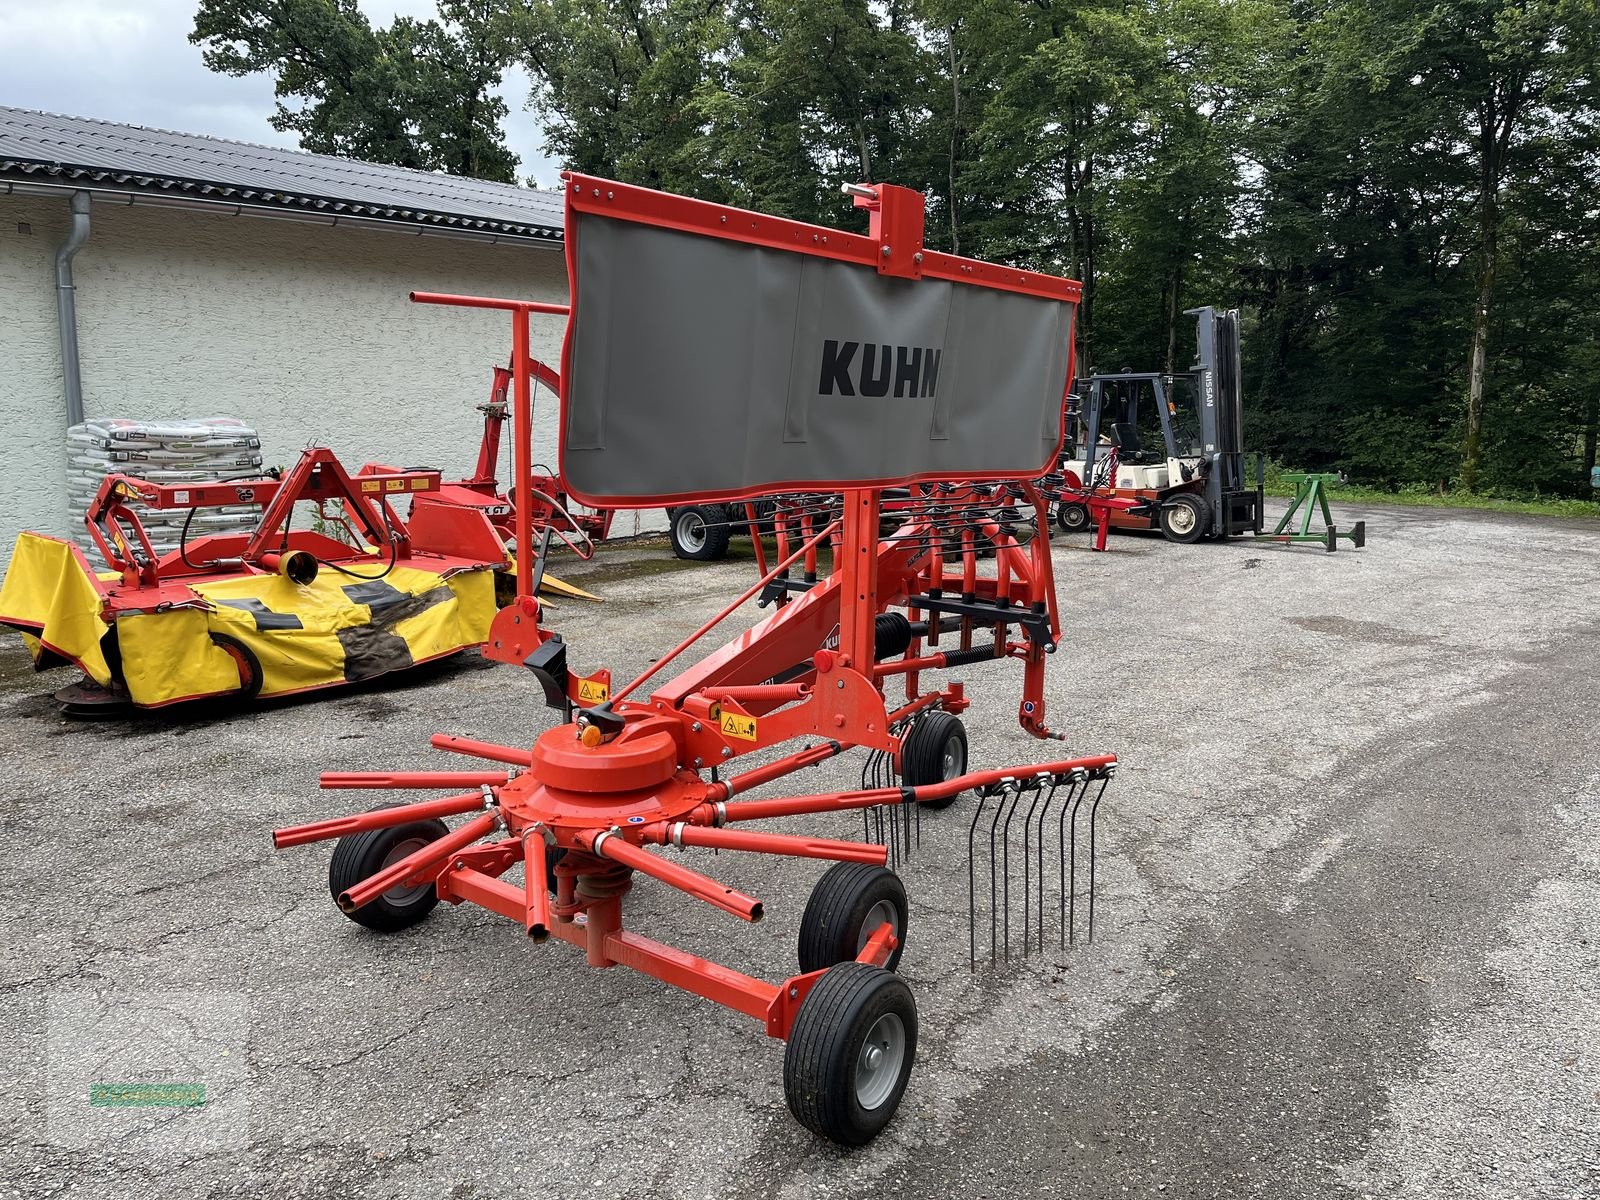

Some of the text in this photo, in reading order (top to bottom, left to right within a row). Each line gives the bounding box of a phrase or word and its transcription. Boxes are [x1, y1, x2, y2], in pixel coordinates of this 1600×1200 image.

[819, 340, 941, 398] KUHN
[1205, 371, 1214, 407] NISSAN
[493, 506, 504, 514] GT
